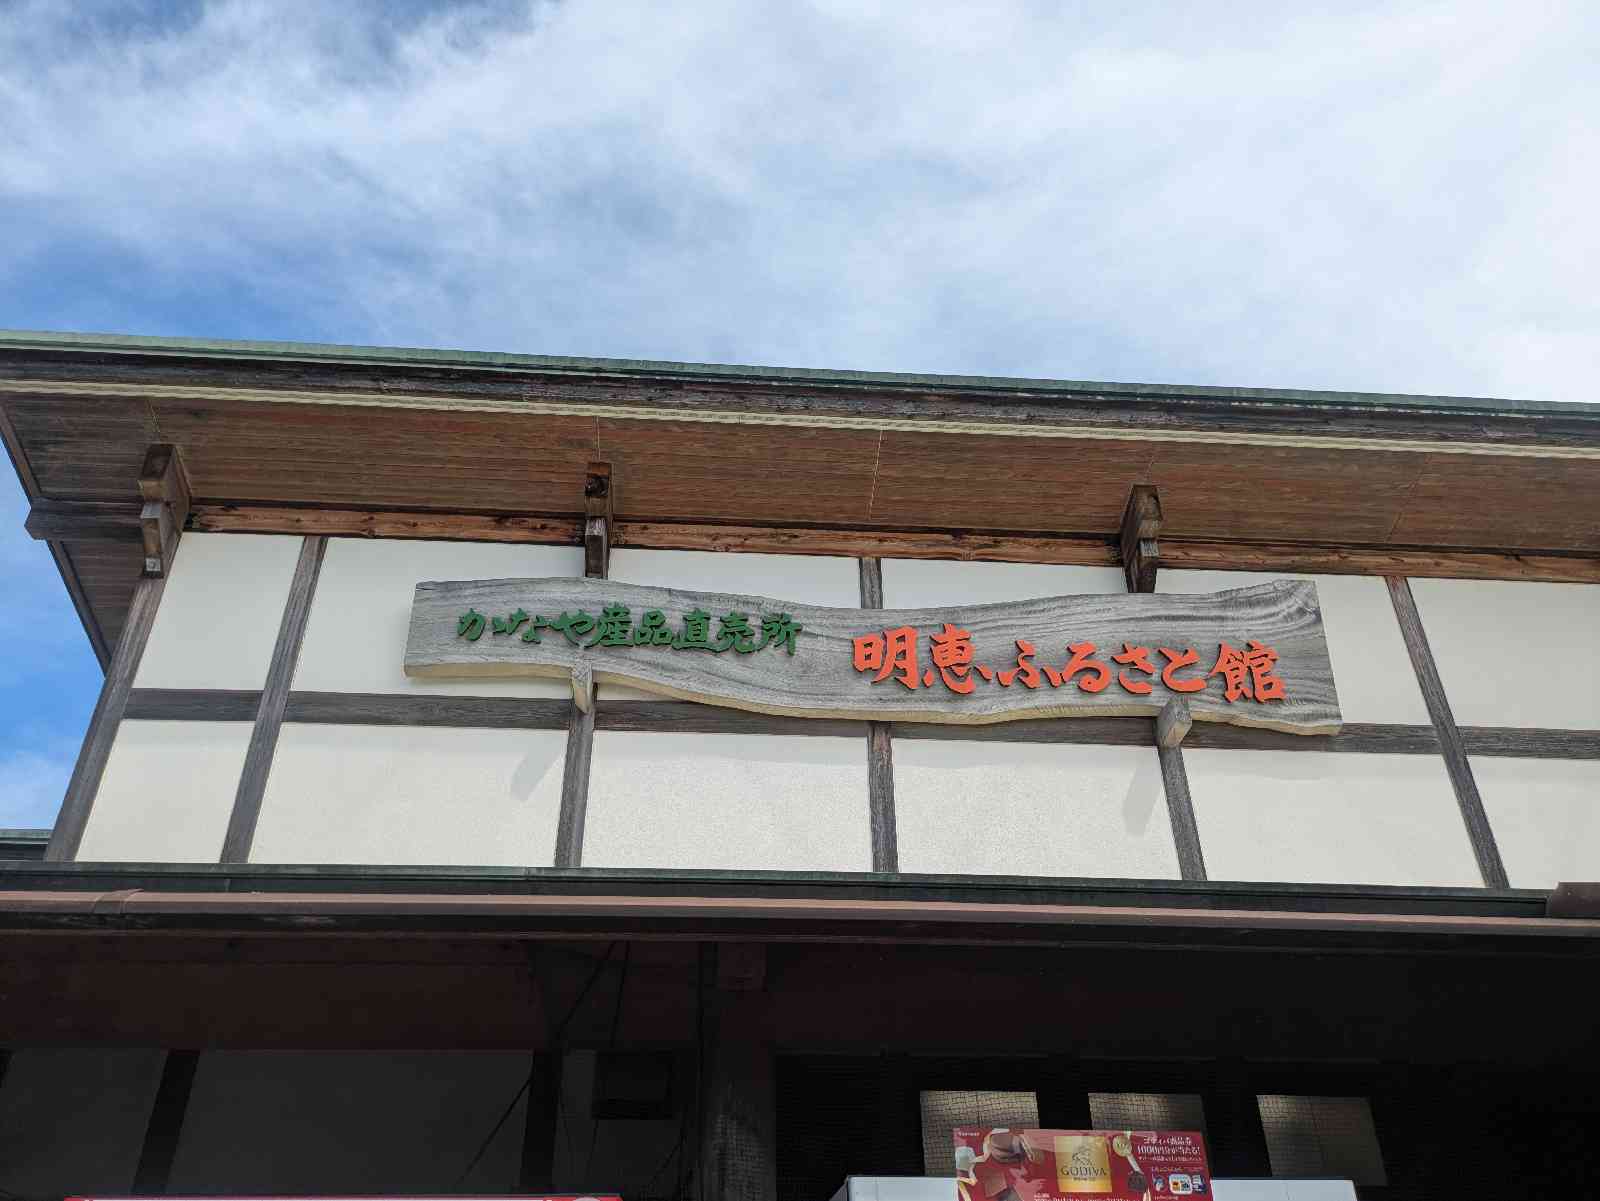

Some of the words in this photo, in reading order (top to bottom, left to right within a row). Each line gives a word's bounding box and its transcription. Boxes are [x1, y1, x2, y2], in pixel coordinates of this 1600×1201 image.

[457, 606, 801, 658] かなや産品直売所
[853, 624, 1285, 703] 明恵ふるさと館
[1060, 1165, 1108, 1177] GODIVA
